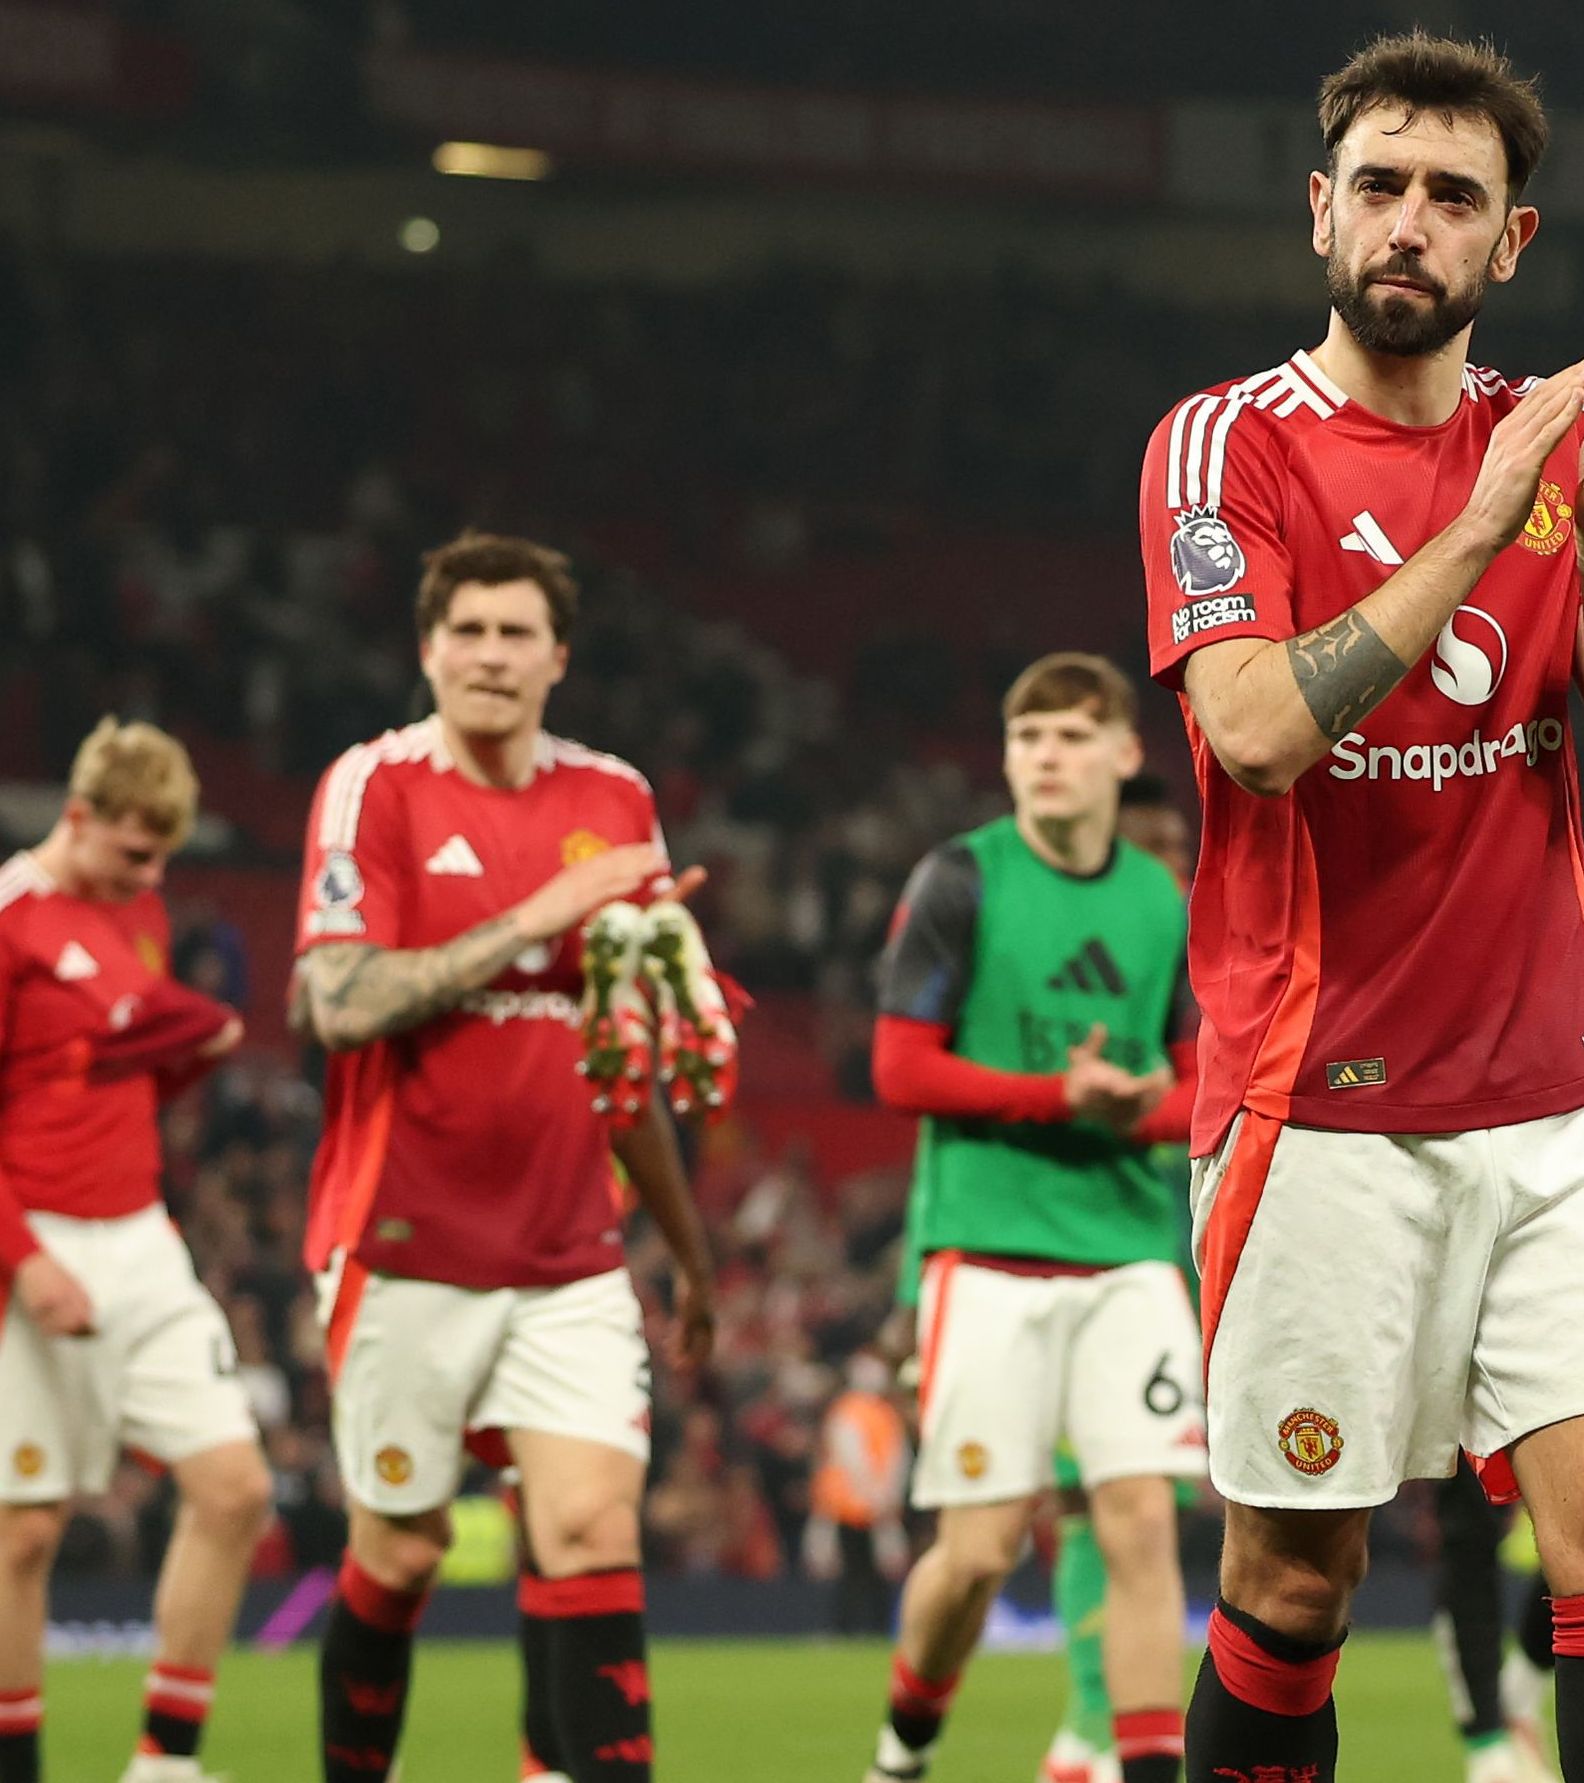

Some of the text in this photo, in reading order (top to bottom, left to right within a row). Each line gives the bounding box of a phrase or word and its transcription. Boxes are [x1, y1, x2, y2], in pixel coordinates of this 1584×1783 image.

[1524, 531, 1564, 550] UNITED
[1172, 596, 1246, 626] No room
[1193, 608, 1256, 633] racism
[1329, 718, 1563, 792] Snapdrago
[1144, 1349, 1204, 1417] 6
[1295, 1458, 1333, 1471] UNITED
